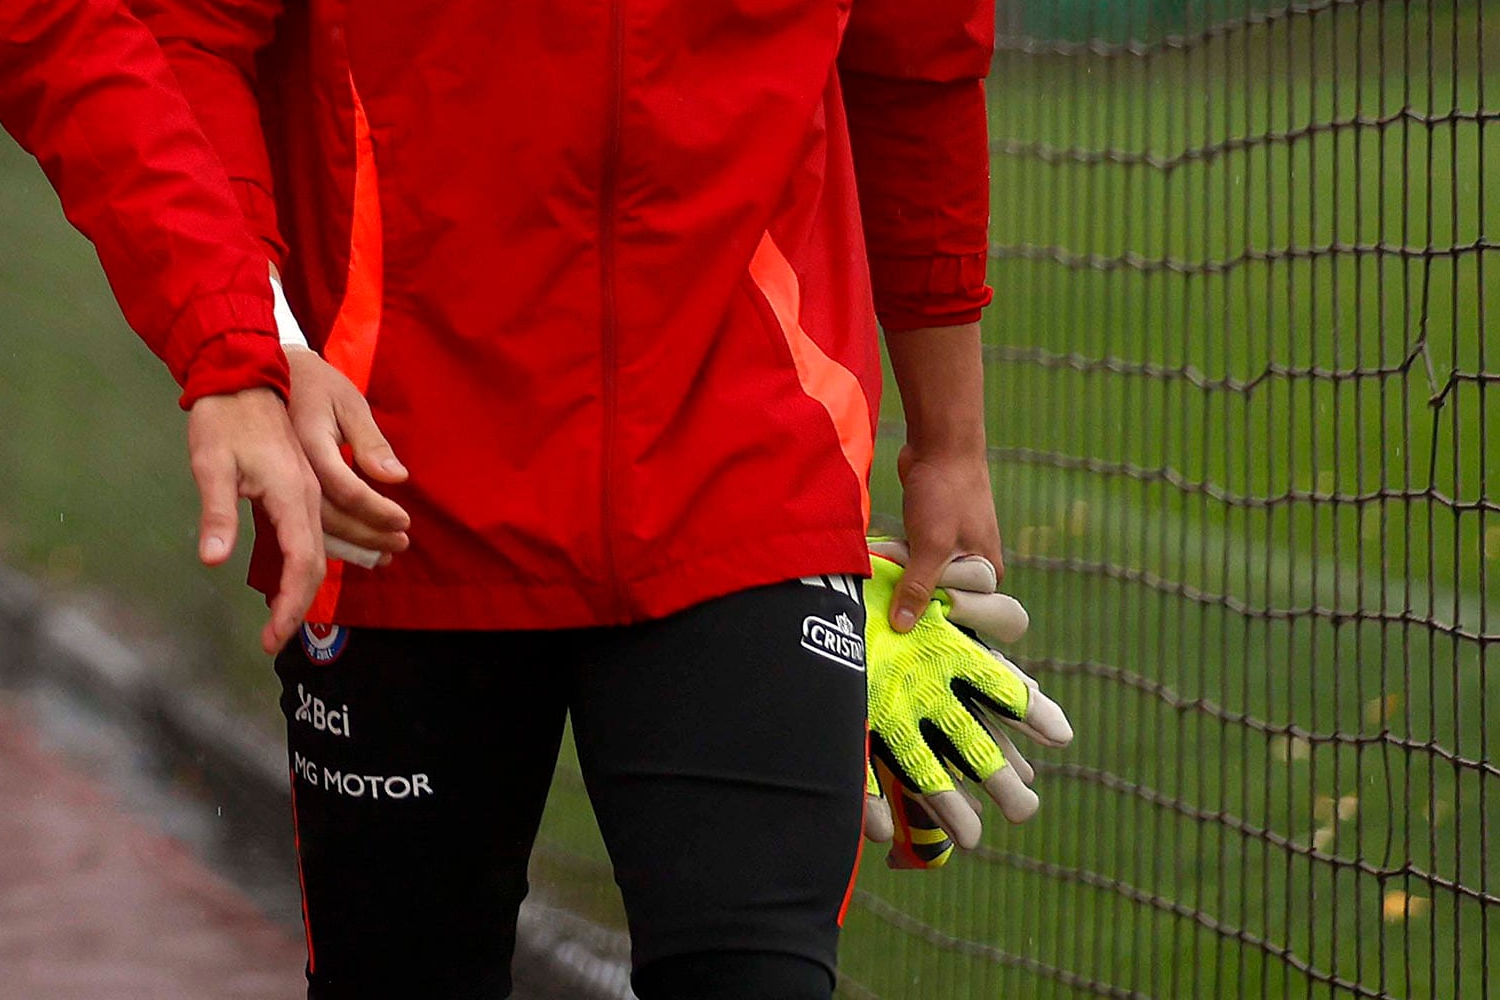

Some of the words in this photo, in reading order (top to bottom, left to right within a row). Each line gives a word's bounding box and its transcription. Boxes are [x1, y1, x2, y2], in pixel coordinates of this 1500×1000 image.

[313, 697, 350, 737] Bci
[294, 751, 318, 786] MG
[324, 767, 433, 799] MOTOR
